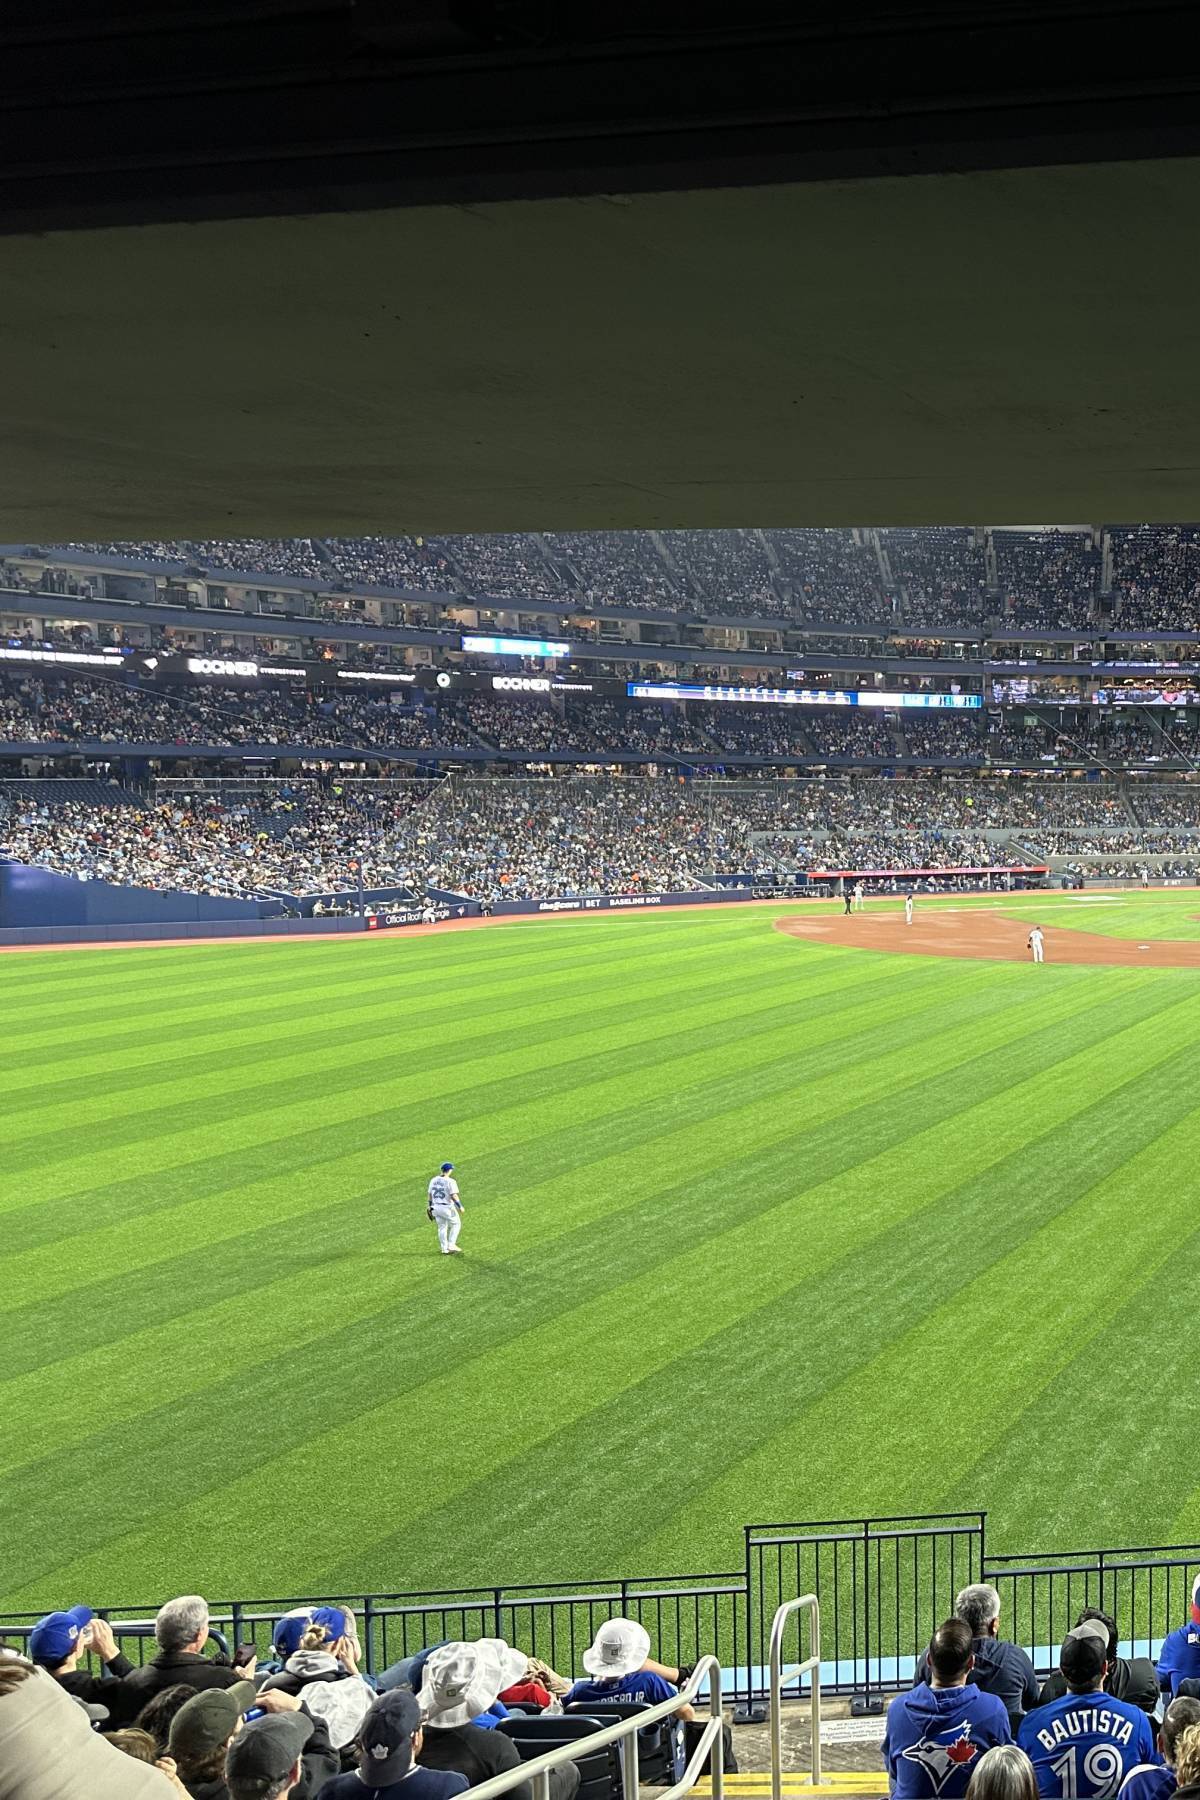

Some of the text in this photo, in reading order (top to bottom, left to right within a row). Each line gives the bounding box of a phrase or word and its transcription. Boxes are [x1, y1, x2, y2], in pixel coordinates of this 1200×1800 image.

[586, 899, 600, 908] BET
[609, 896, 645, 906] BASELINE
[645, 896, 661, 904] BOX
[385, 913, 407, 925] Official
[432, 1187, 445, 1199] 25
[1037, 1709, 1134, 1752] BAUTISTA
[1050, 1743, 1123, 1800] 19
